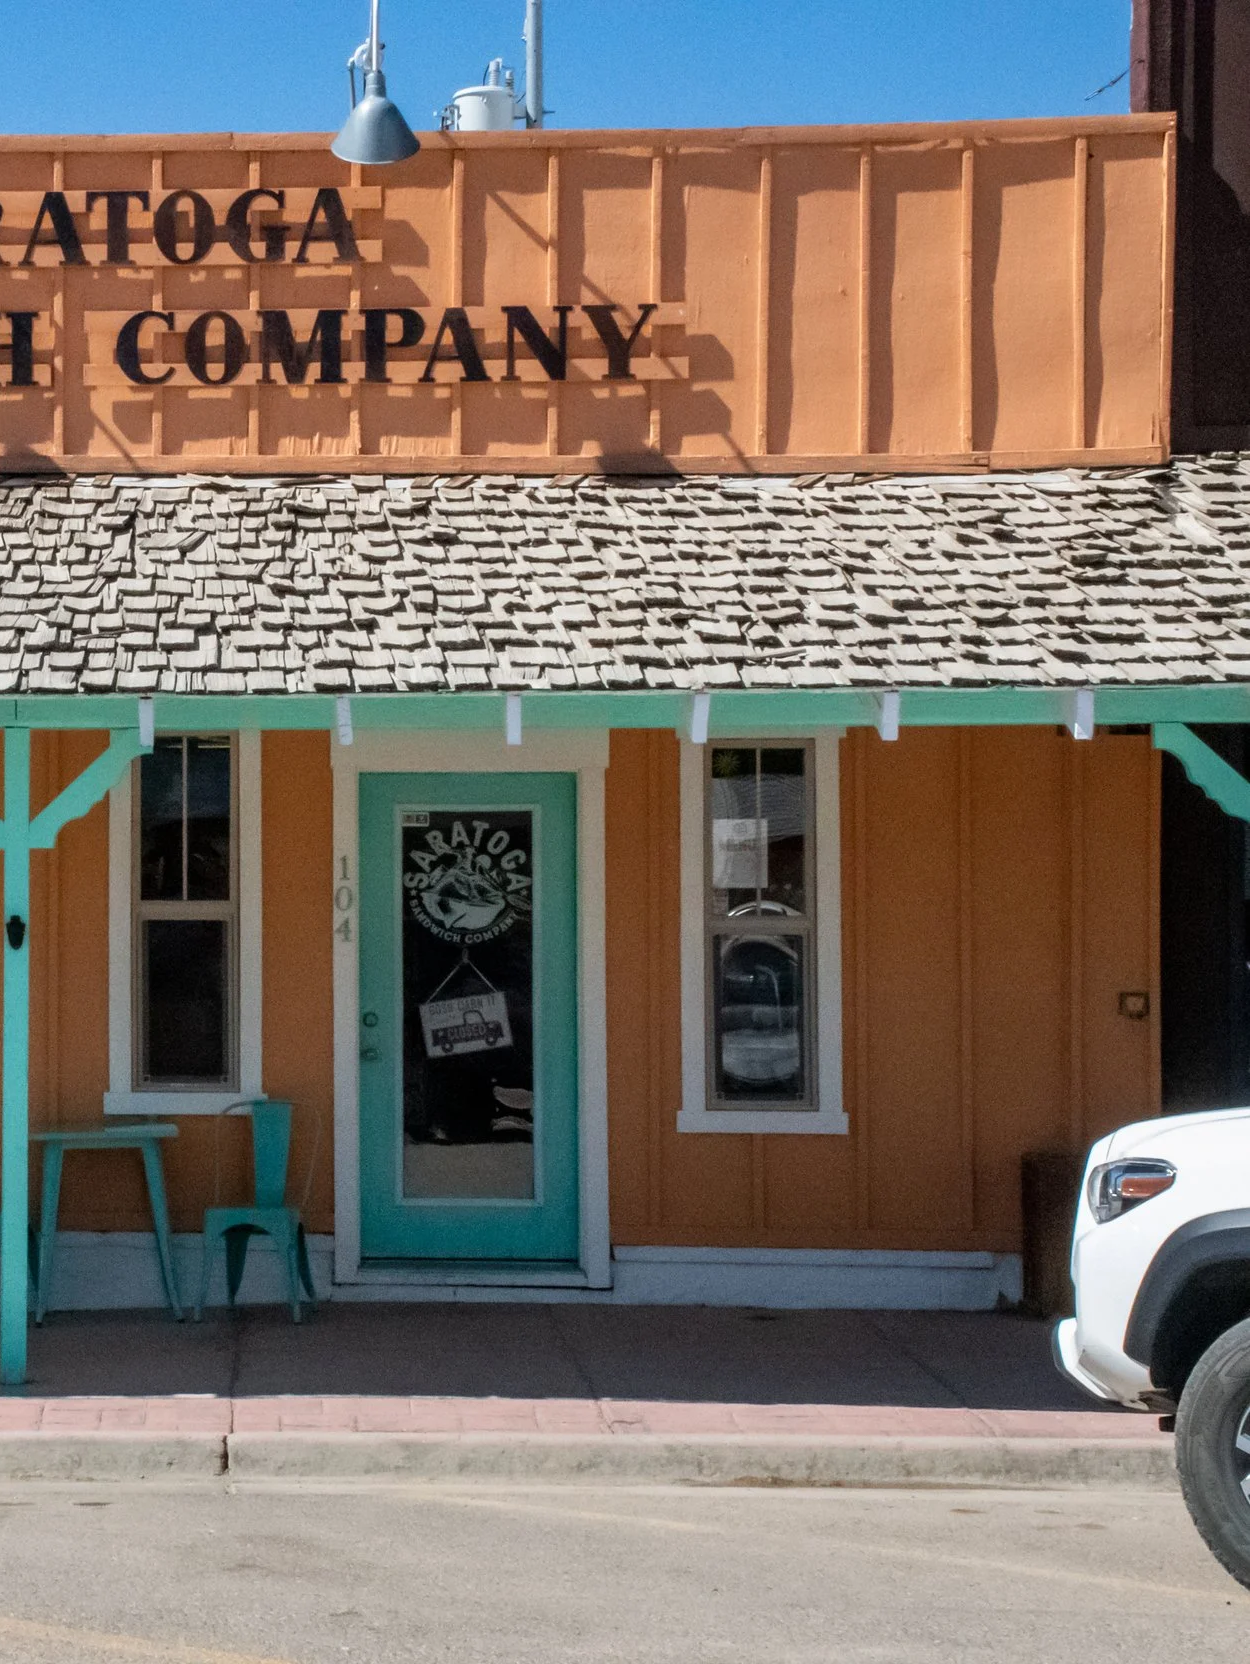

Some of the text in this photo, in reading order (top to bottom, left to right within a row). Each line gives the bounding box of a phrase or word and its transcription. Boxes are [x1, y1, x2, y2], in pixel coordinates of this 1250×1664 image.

[116, 303, 658, 385] COMPANY
[403, 819, 532, 892] SARATOGA
[408, 899, 519, 944] SANDWICH COMPANY
[447, 1023, 487, 1040] CLOSED
